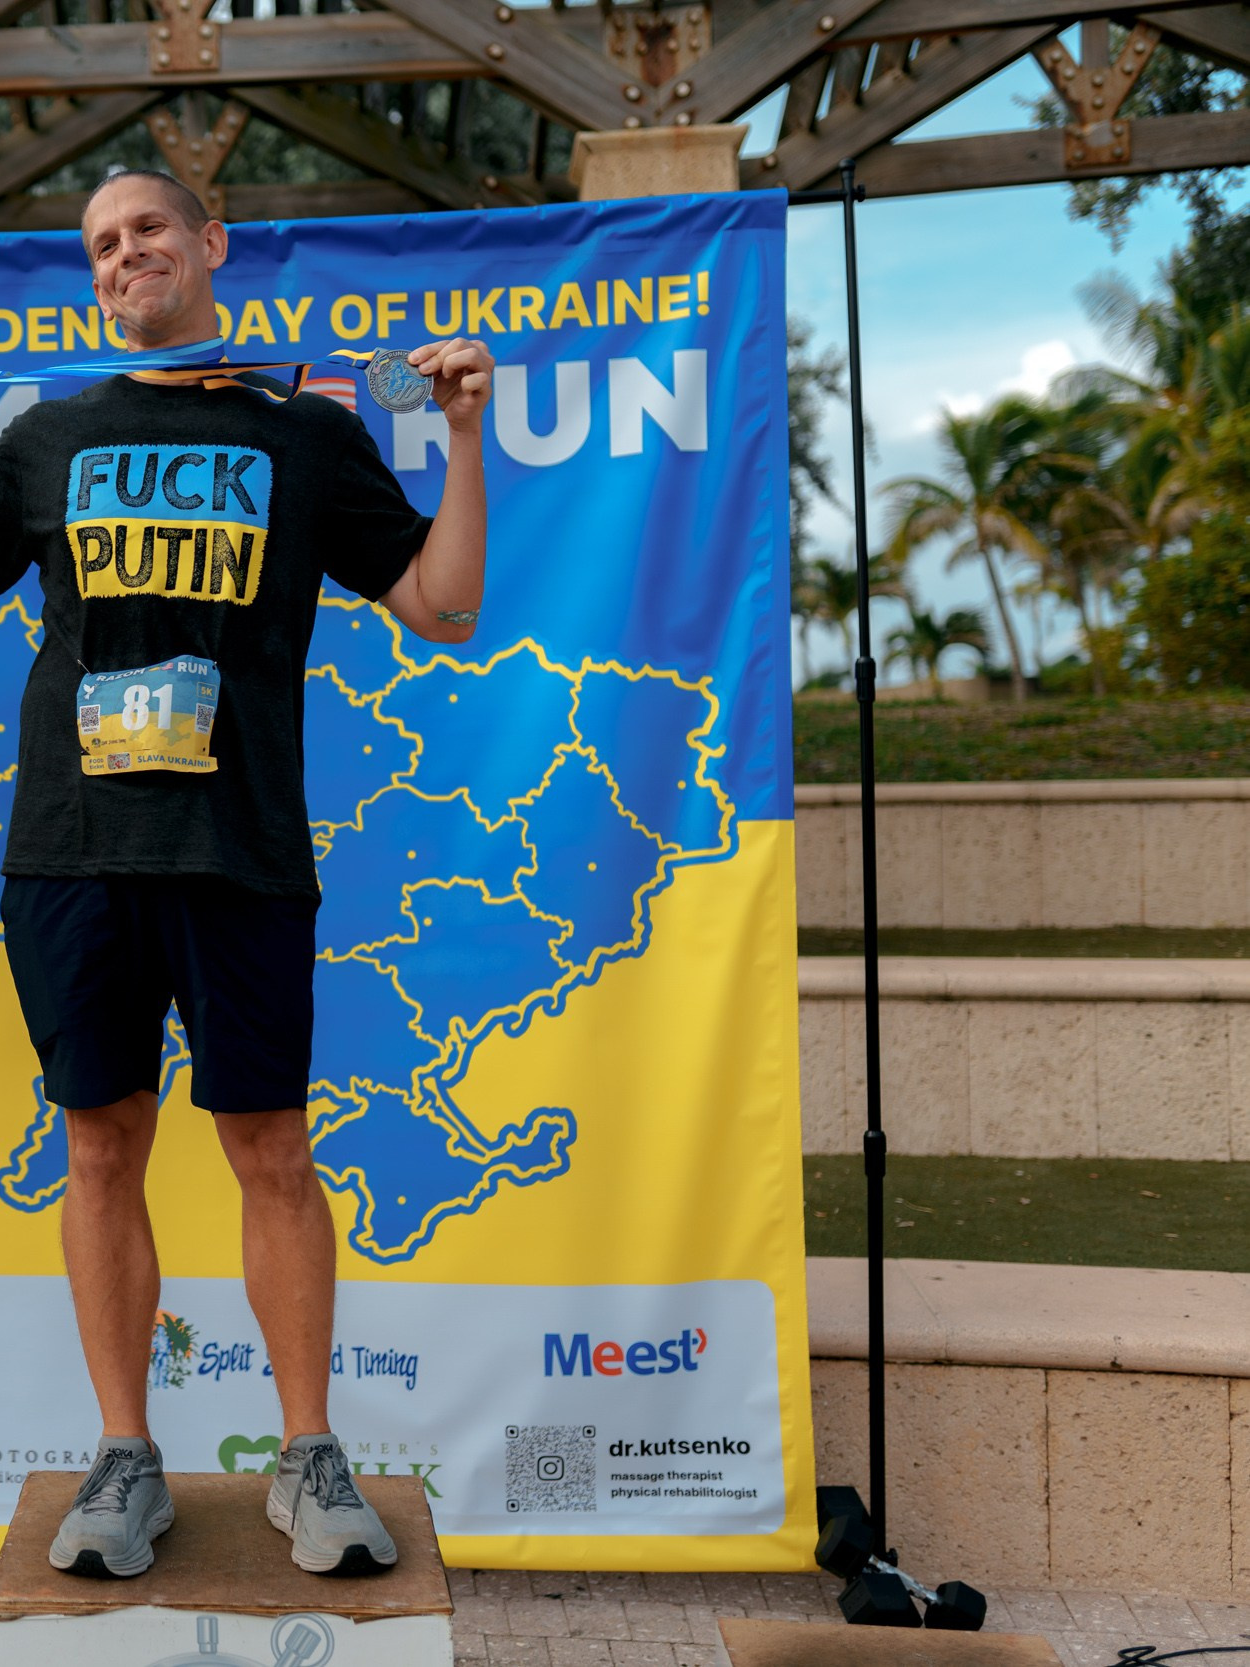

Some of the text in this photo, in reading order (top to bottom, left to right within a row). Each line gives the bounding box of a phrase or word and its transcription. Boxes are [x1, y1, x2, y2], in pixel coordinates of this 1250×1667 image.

[330, 292, 408, 341] OF
[424, 271, 710, 336] UKRAINE!
[77, 452, 258, 515] FUCK
[76, 524, 255, 600] PUTIN
[96, 661, 208, 682] RAZOM RUN
[200, 686, 213, 697] 5K
[121, 683, 174, 731] 81
[137, 755, 166, 764] SLAVA
[544, 1329, 699, 1377] Meest
[198, 1342, 256, 1381] Split
[351, 1346, 419, 1390] Timing
[341, 1440, 439, 1456] RMER'S
[609, 1436, 751, 1457] dr.kutsenko
[611, 1470, 723, 1483] massage therapist
[611, 1486, 758, 1500] physical rehabilitologist
